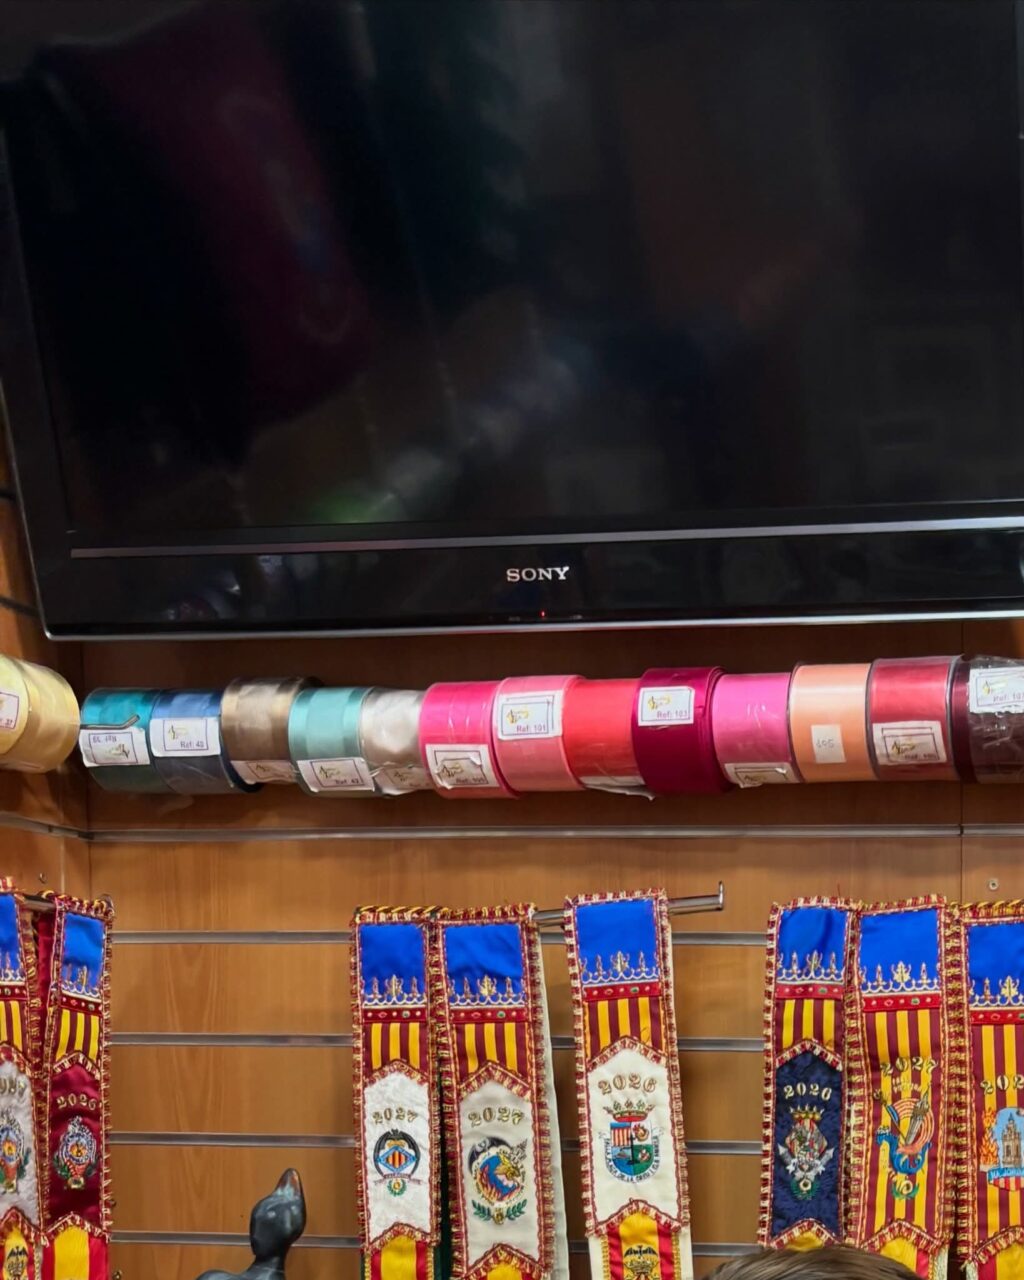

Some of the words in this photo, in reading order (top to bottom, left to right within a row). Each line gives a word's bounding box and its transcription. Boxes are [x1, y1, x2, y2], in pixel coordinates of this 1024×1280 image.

[506, 565, 570, 582] SONY
[879, 1056, 938, 1076] 2027
[597, 1072, 658, 1096] 2026
[56, 1091, 98, 1111] 2026
[371, 1106, 419, 1125] 2027
[467, 1106, 525, 1127] 2027
